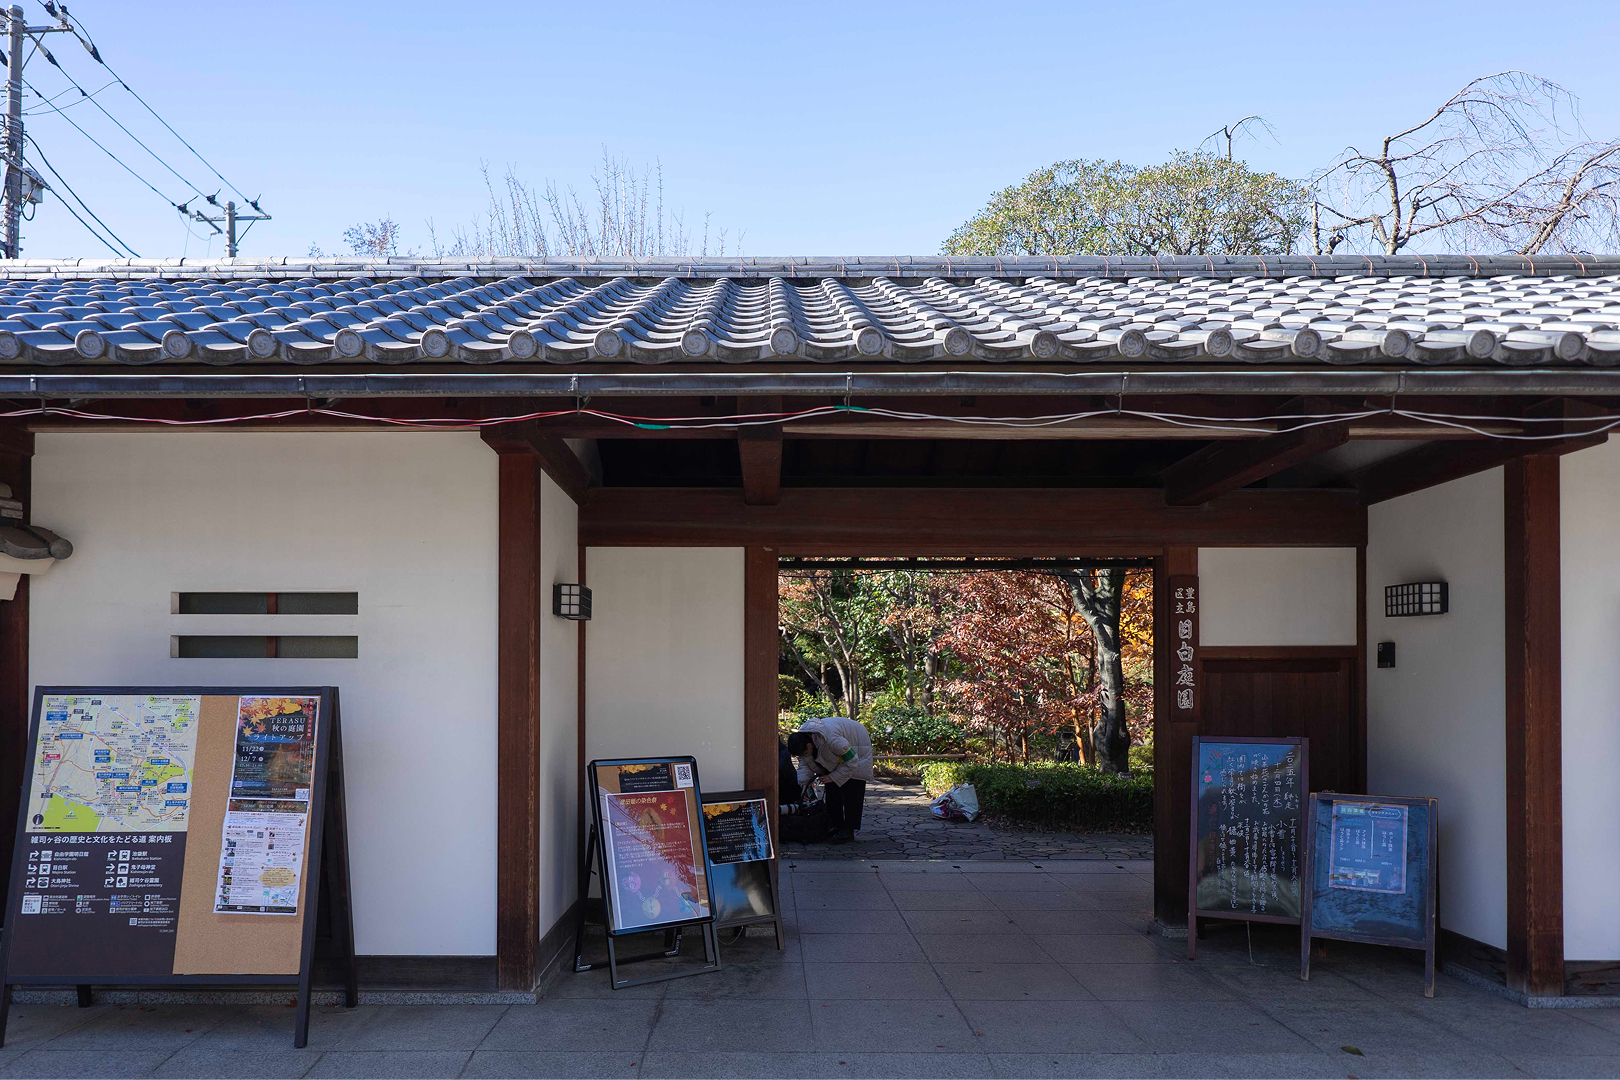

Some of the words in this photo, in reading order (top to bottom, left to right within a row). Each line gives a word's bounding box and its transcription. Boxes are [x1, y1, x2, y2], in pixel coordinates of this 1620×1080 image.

[1176, 618, 1196, 709] 目白庭園
[272, 724, 305, 733] 秋の庭園
[253, 733, 305, 741] ライトアップ
[1275, 819, 1288, 841] 小雪
[148, 835, 173, 844] 案内板
